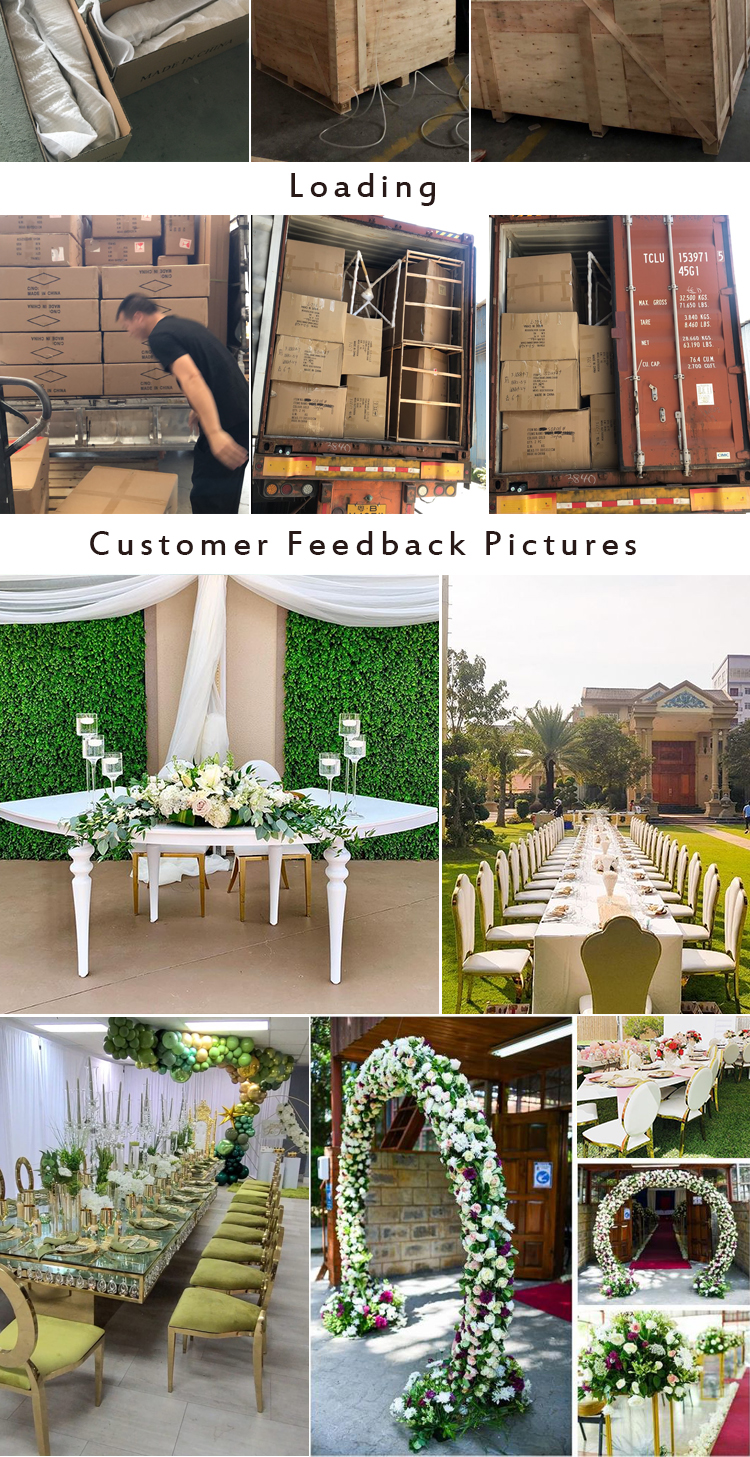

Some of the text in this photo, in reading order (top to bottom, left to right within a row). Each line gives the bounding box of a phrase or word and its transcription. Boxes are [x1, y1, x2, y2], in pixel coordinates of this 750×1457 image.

[140, 38, 234, 83] MADE IN CHINA
[643, 250, 725, 264] TCLU 153971 5
[678, 265, 700, 277] 45G1
[564, 472, 597, 486] 3840
